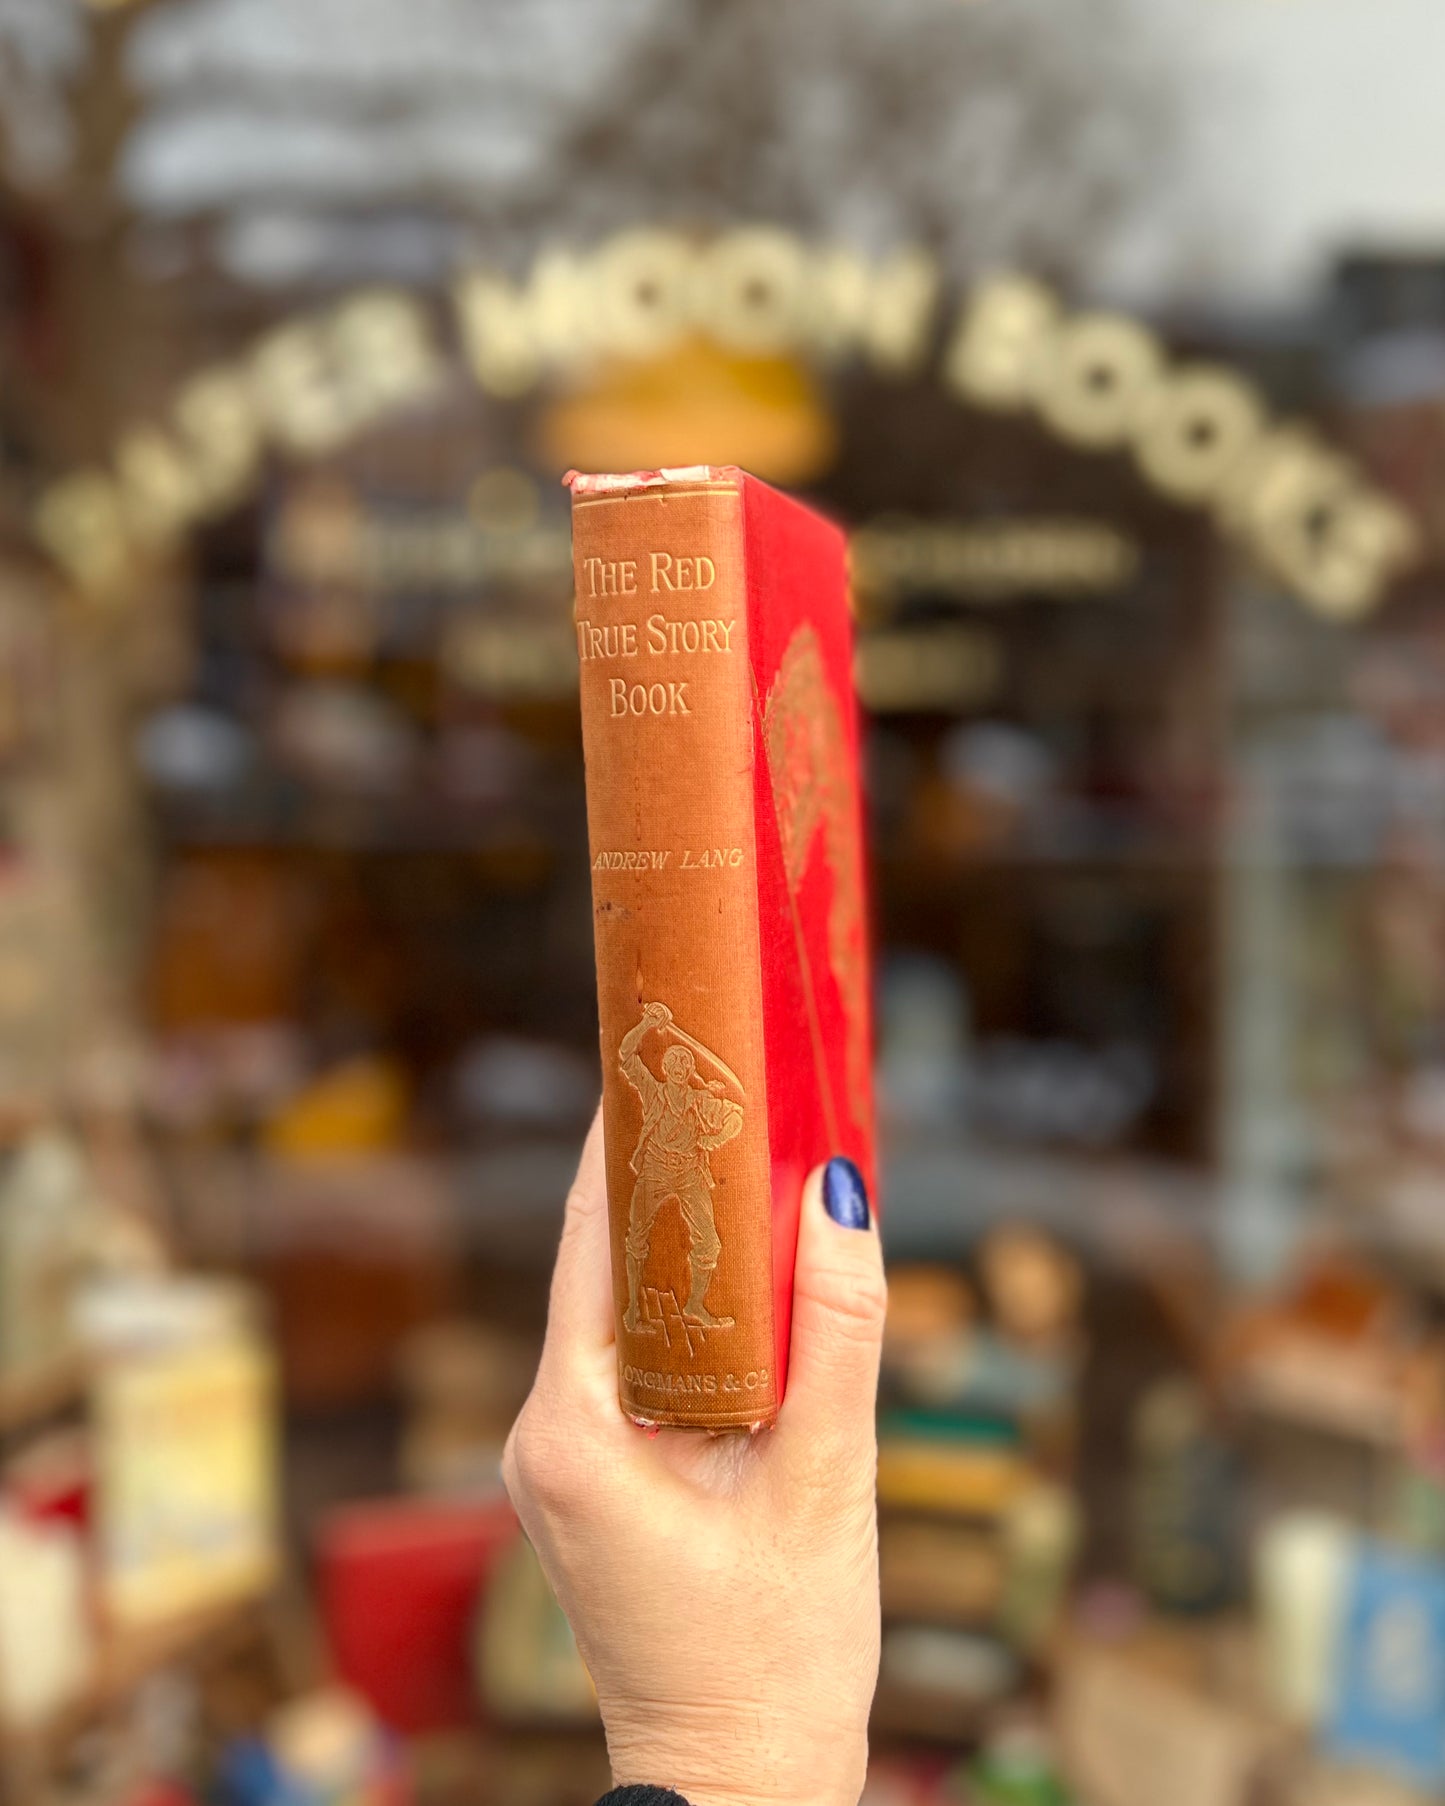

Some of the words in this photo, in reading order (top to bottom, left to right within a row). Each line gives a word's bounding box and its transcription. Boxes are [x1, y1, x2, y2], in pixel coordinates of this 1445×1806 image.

[583, 557, 638, 598] THE
[649, 552, 716, 593] RED
[577, 620, 638, 661] TRUE
[646, 614, 736, 655] STORY
[608, 677, 692, 717] BOOK
[592, 851, 672, 871] ANDREW
[679, 847, 745, 870] LANG
